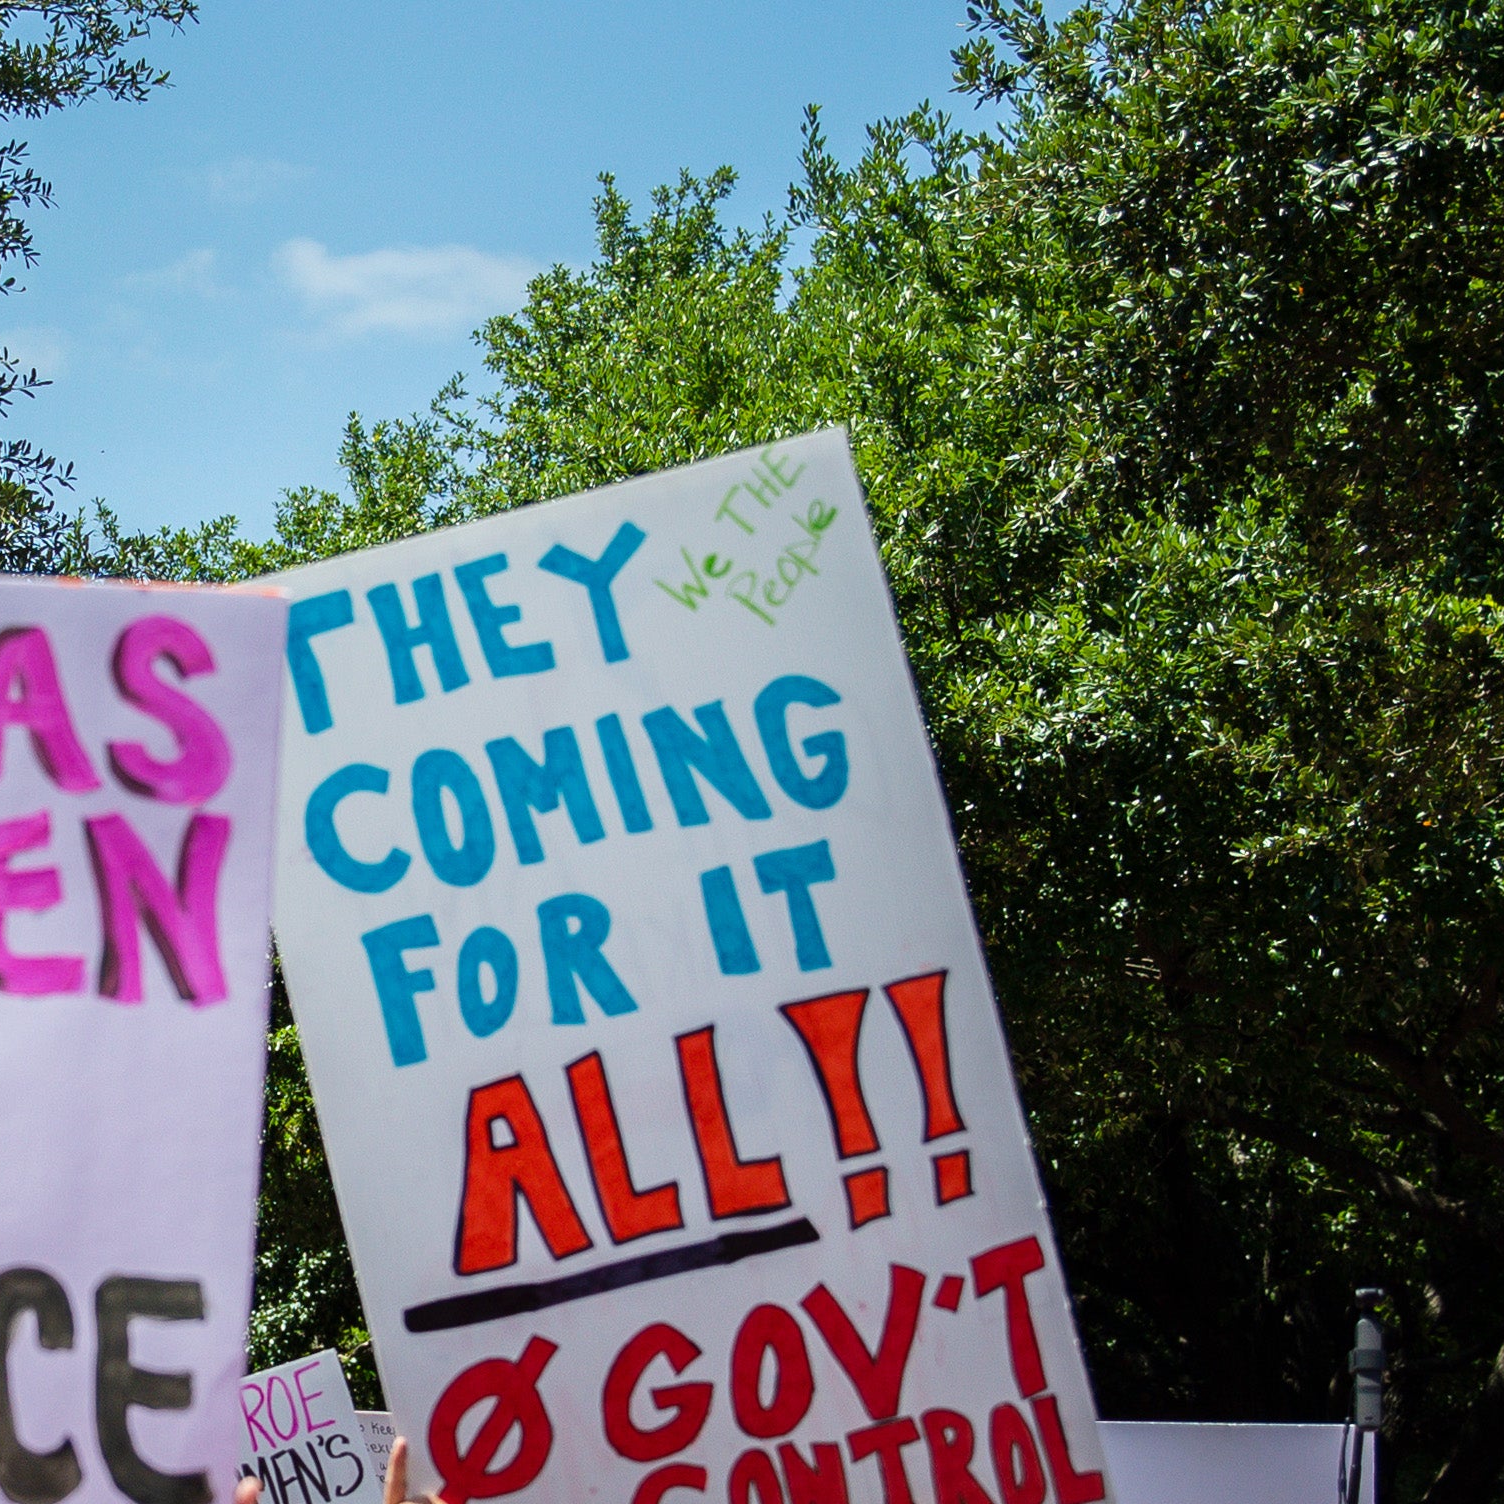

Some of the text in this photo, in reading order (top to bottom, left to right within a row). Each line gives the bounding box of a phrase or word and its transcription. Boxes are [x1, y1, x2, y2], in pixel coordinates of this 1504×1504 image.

[285, 521, 646, 735] THEY
[305, 674, 850, 893] COMING
[361, 838, 836, 1067] FOR IT
[453, 968, 975, 1278] ALL!!
[602, 1235, 1047, 1463] GOV'T
